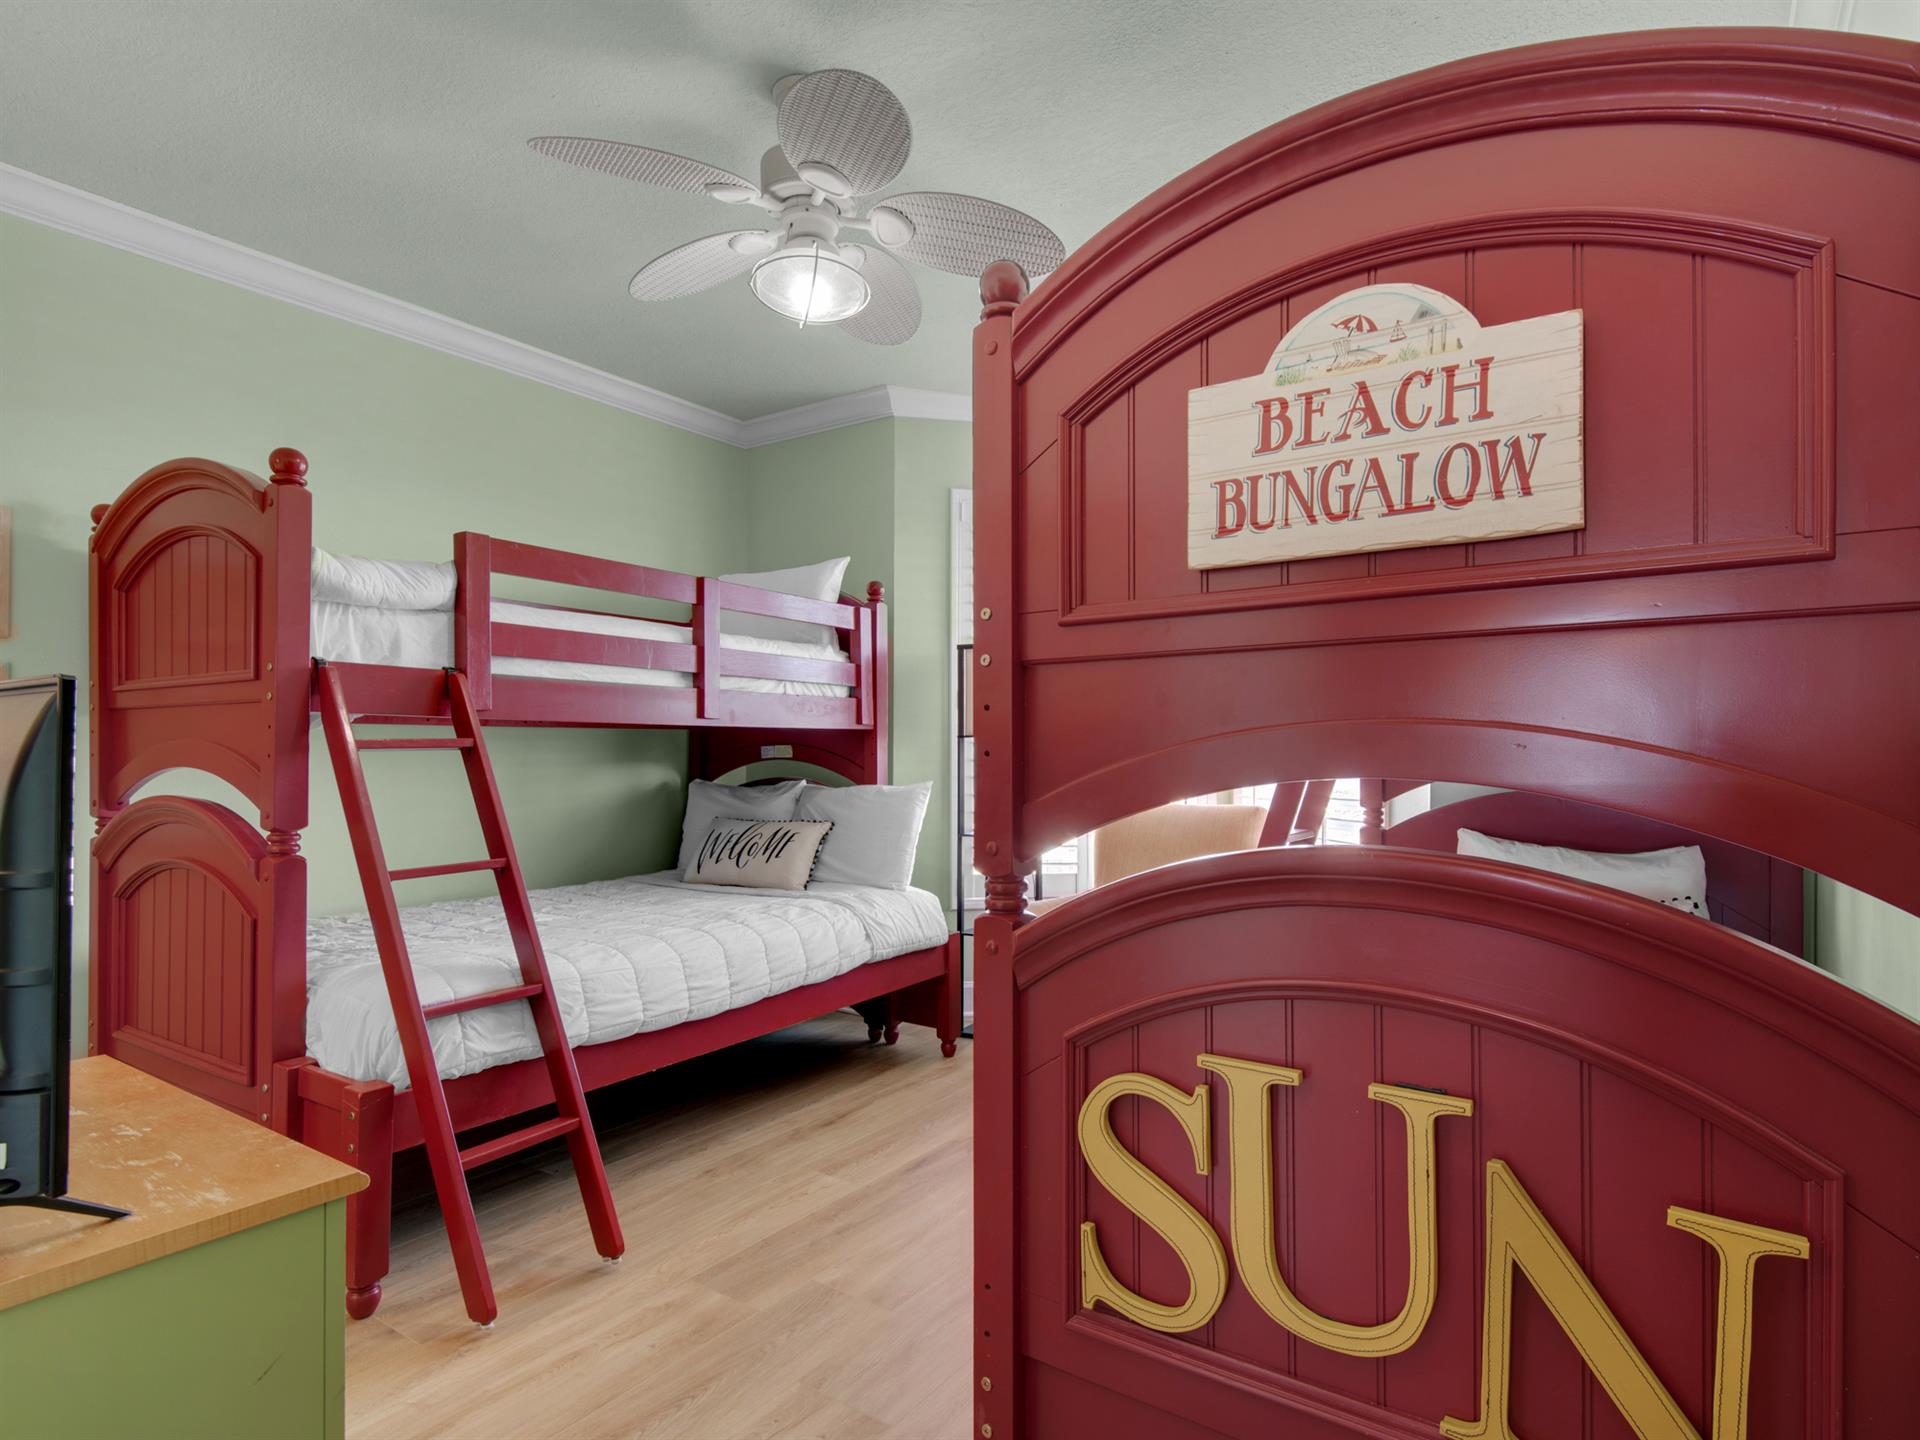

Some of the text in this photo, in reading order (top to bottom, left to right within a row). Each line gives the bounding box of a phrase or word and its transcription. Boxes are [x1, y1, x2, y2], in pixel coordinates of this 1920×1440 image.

[1252, 356, 1495, 457] BEACH
[1211, 432, 1547, 540] BUNGALOW
[1077, 1053, 1809, 1440] SUN
